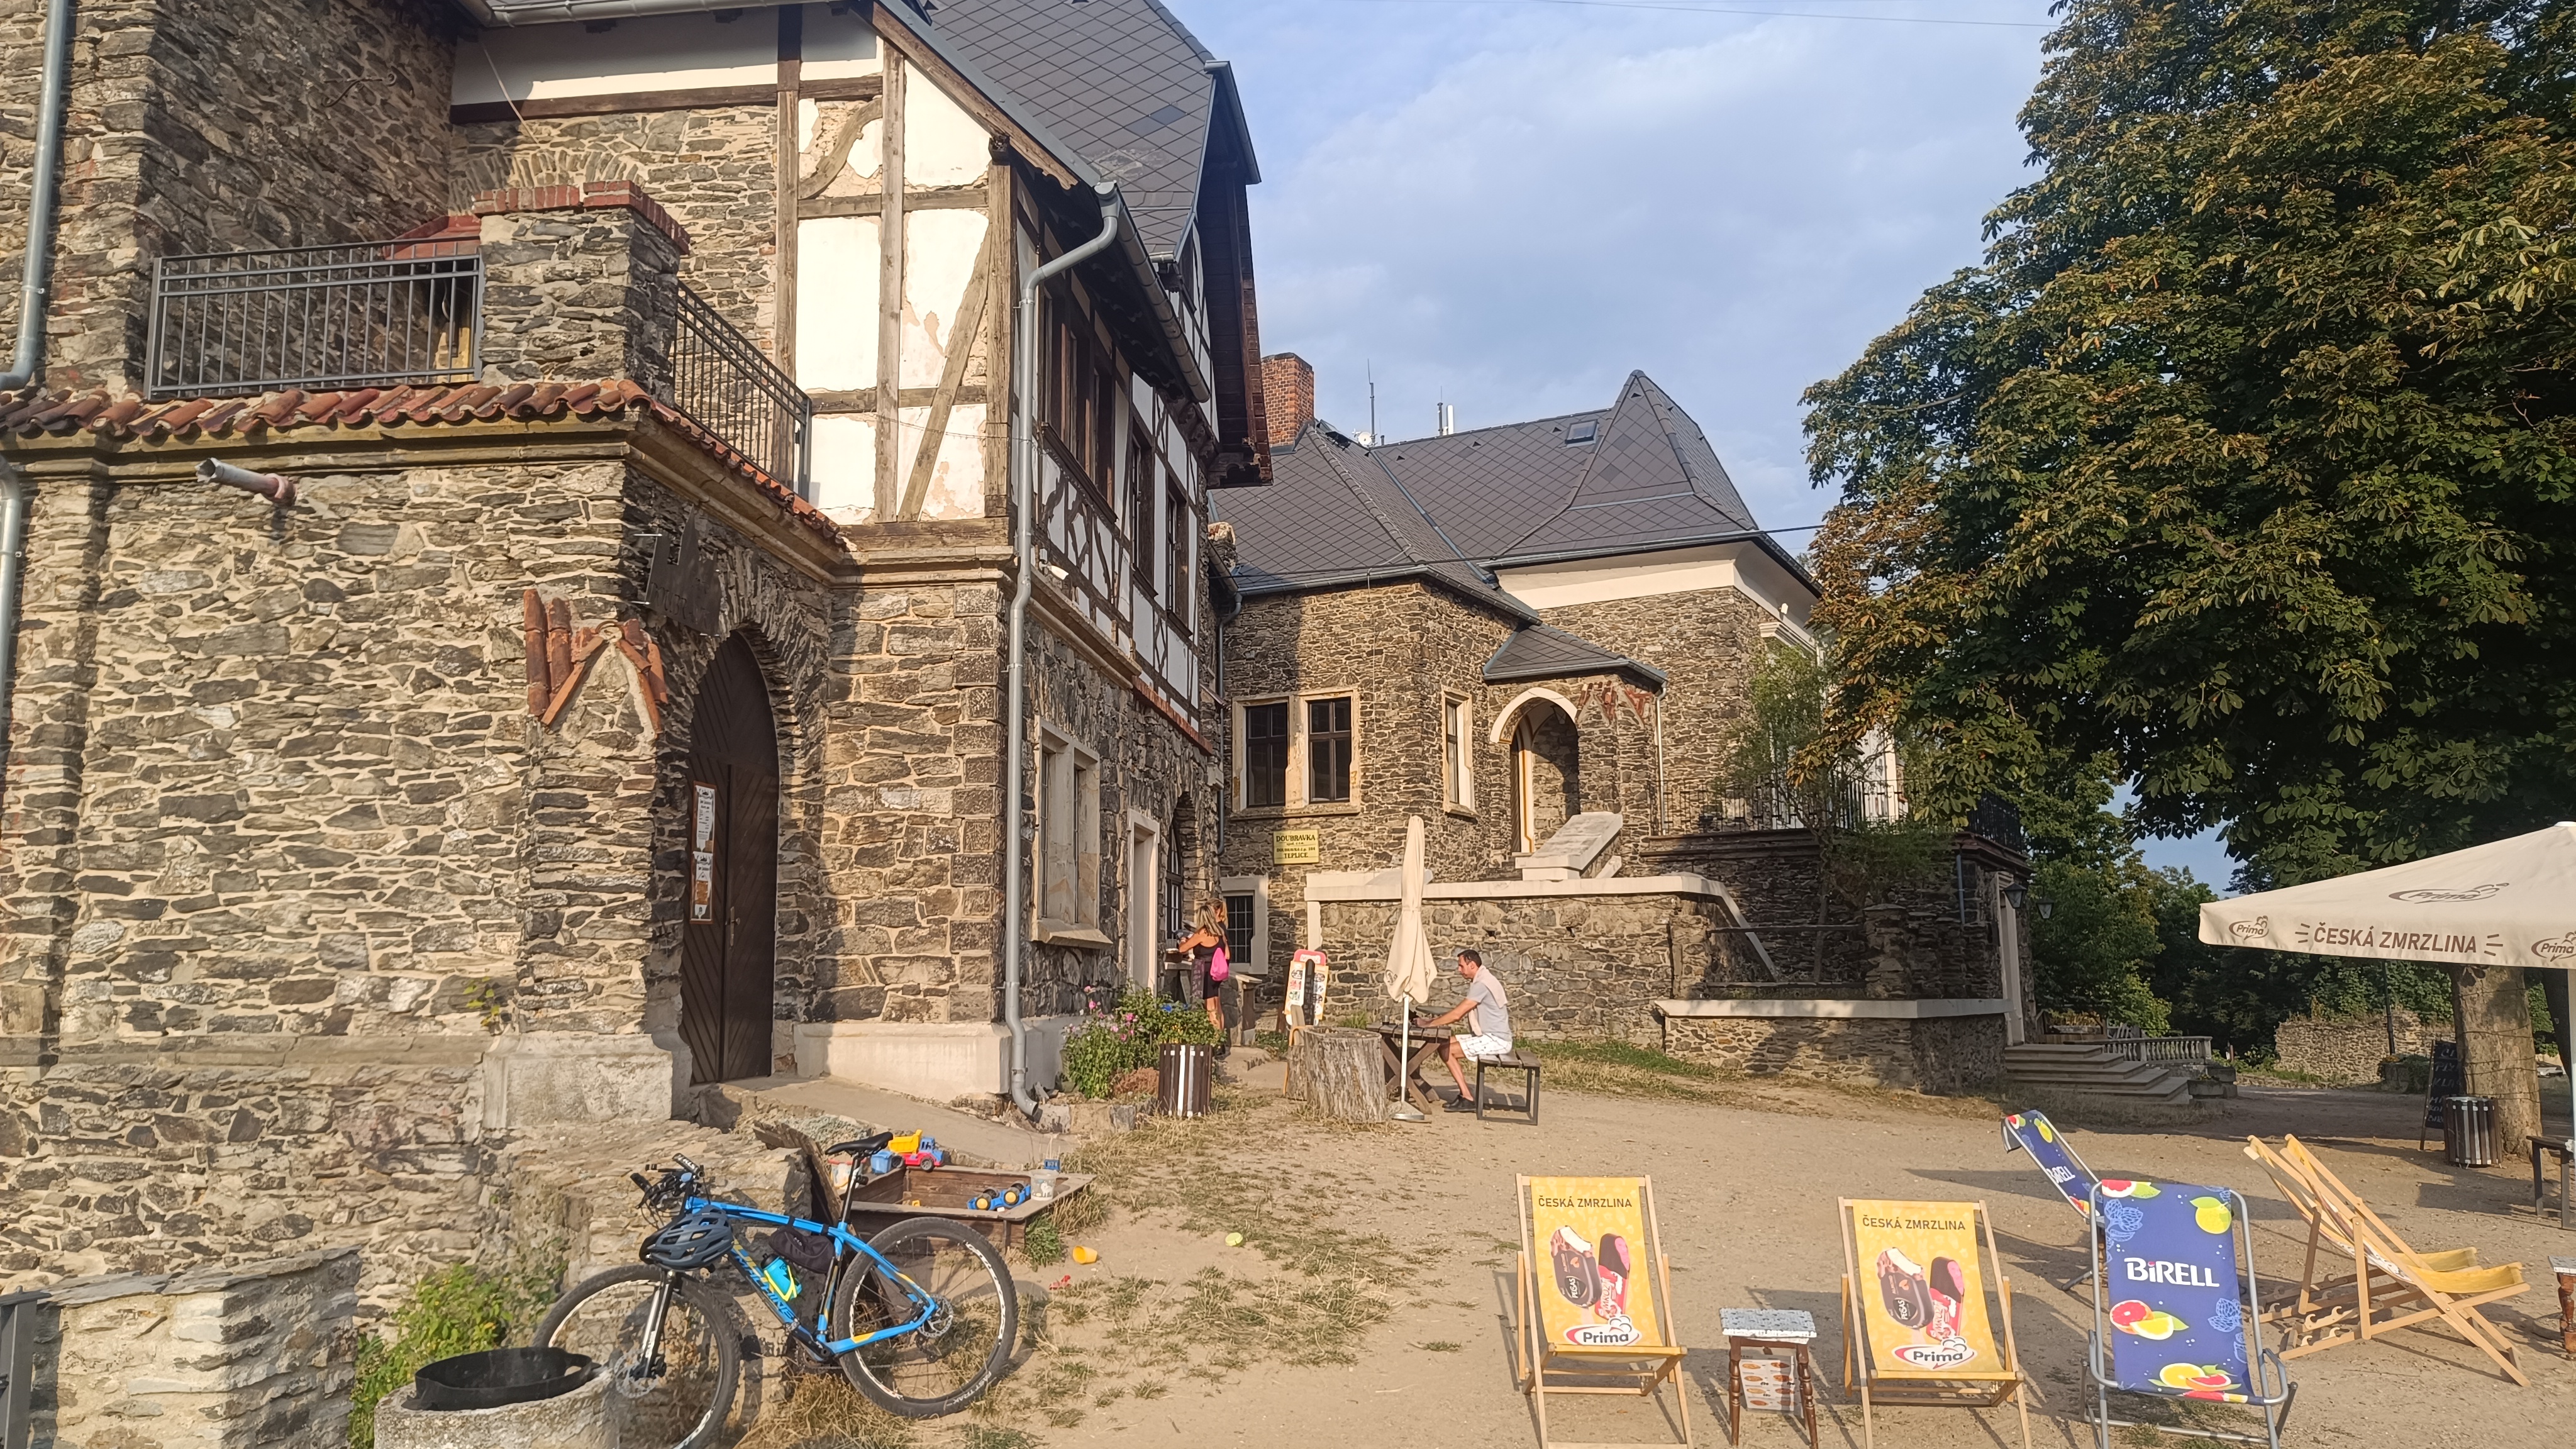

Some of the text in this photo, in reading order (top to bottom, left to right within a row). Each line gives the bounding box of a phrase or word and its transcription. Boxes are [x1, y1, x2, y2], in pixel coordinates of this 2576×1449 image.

[2408, 892, 2481, 900] Prima
[2236, 924, 2264, 935] Prima
[2314, 921, 2477, 953] ČESKÁ ZMRZLINA
[2540, 943, 2575, 954] Prima
[1538, 1195, 1633, 1208] ČESKÁ ZMRZLINA
[1862, 1214, 1966, 1230] ČESKÁ ZMRZLINA
[1569, 1278, 1579, 1299] PEGAS
[1897, 1300, 1909, 1320] PEGAS
[1583, 1331, 1629, 1343] Prima
[1913, 1350, 1963, 1362] Prima
[953, 1389, 975, 1404] TRAK
